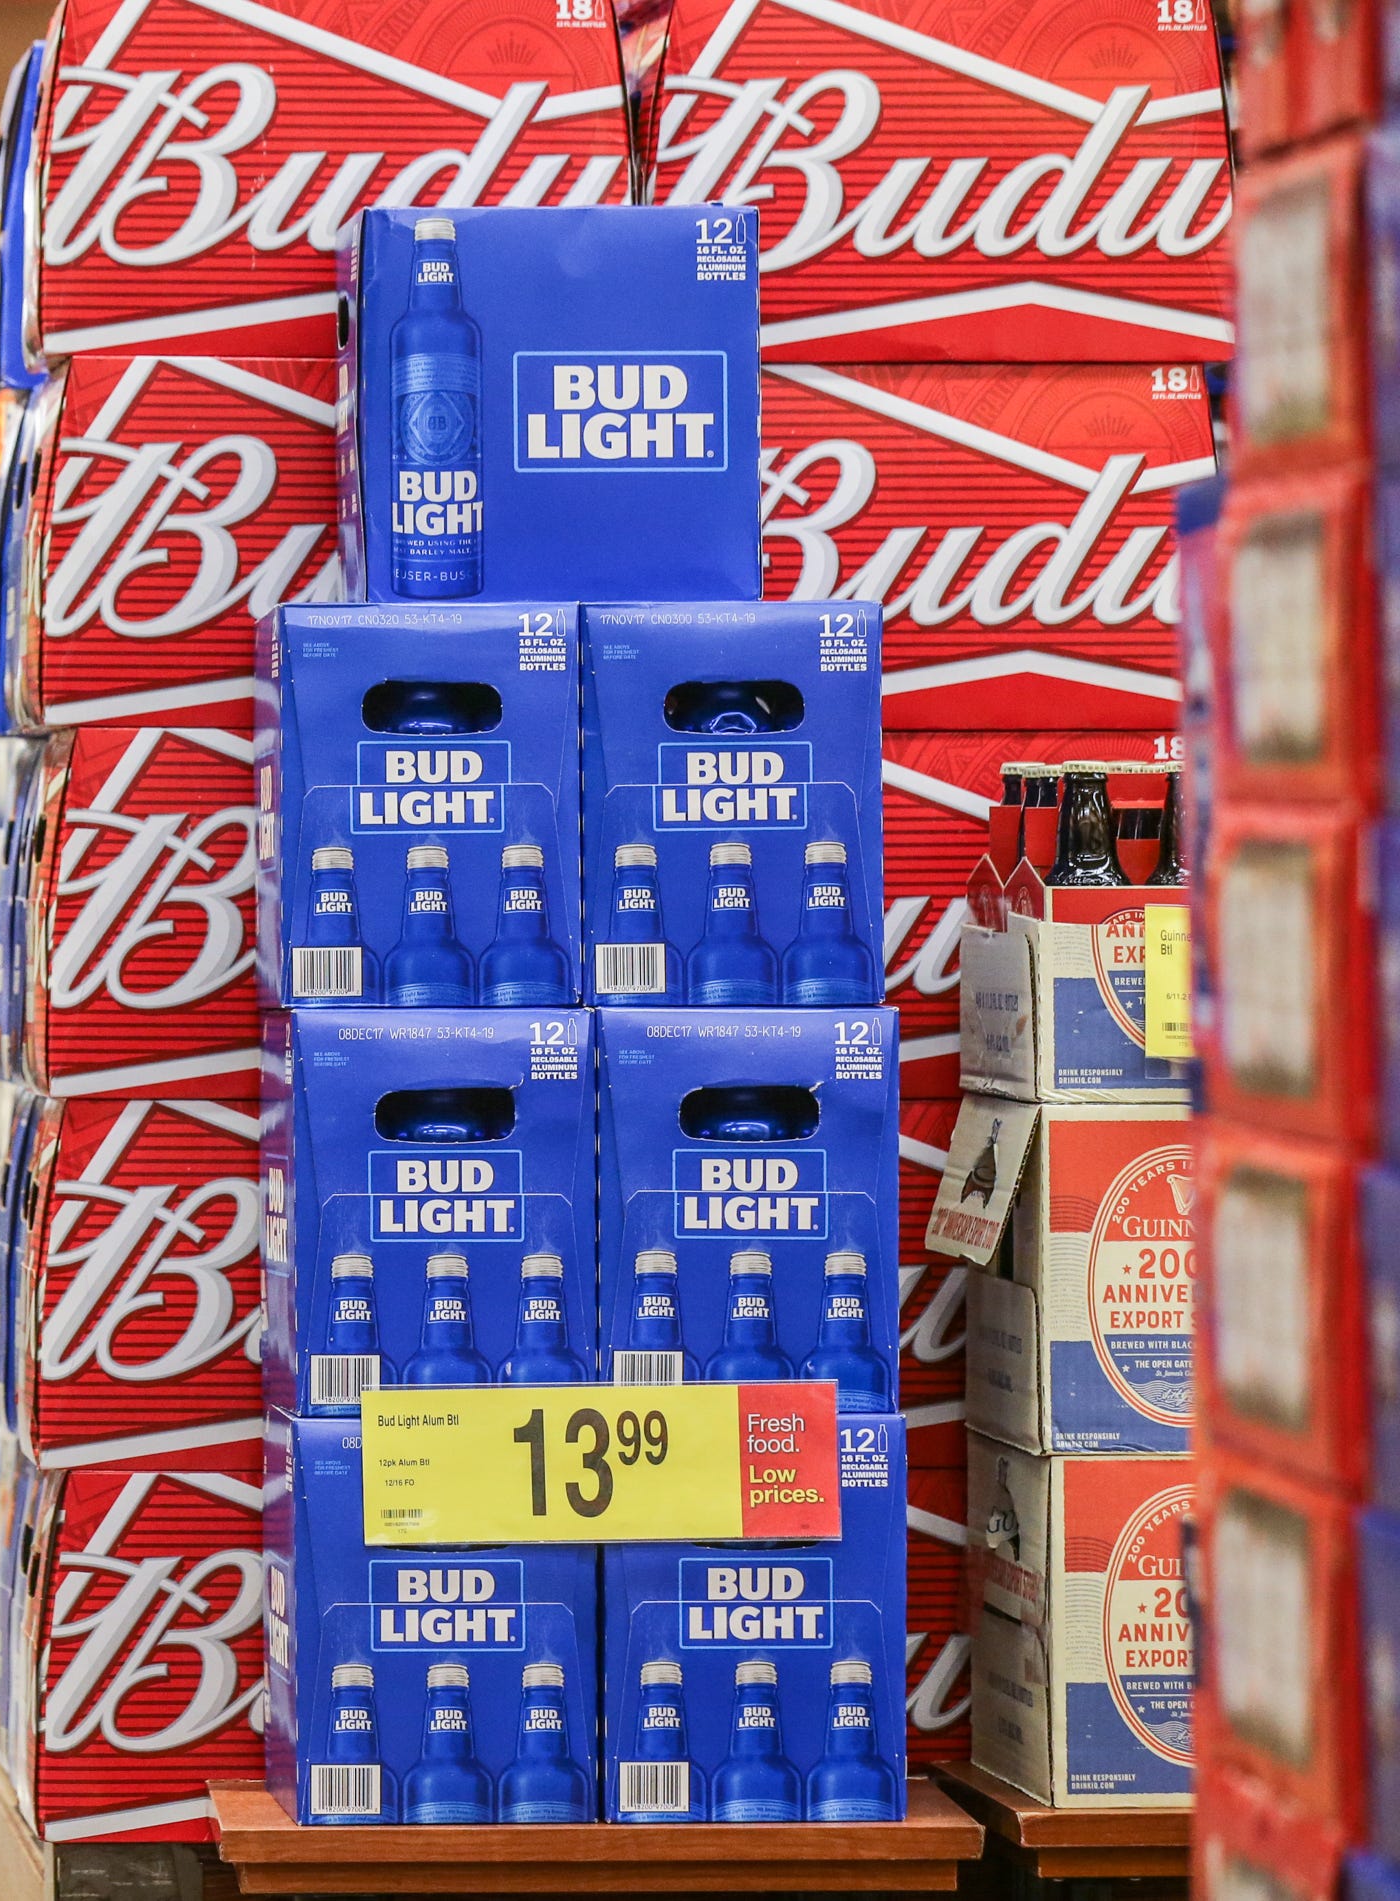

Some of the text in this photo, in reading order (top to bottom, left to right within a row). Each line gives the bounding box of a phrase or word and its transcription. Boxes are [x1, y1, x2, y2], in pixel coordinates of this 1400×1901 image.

[696, 218, 732, 243] 12
[697, 246, 746, 254] 16 FL. OZ.
[420, 262, 452, 274] BUD
[418, 271, 453, 282] LIGHT
[697, 272, 745, 280] BOTTLES
[1152, 368, 1188, 392] 18
[554, 365, 687, 410] BUD
[528, 413, 714, 459] LIGHT
[400, 471, 476, 502] BUD
[393, 501, 483, 535] LIGHT
[308, 614, 462, 625] 17NOV17 CN0320 53-KT4-19
[516, 612, 552, 636] 12
[600, 613, 755, 624] 17NOV17 CN0300 53-KT4-19
[817, 613, 853, 637] 12
[386, 751, 482, 783] BUD
[687, 752, 783, 783] BUD
[360, 791, 494, 824] LIGHT
[663, 788, 797, 821] LIGHT
[321, 892, 347, 902] BUD
[416, 891, 442, 902] BUD
[511, 890, 537, 900] BUD
[624, 889, 650, 899] BUD
[719, 888, 745, 898] BUD
[814, 887, 840, 897] BUD
[411, 901, 447, 911] LIGHT
[506, 900, 541, 910] LIGHT
[619, 898, 655, 909] LIGHT
[714, 897, 750, 909] LIGHT
[809, 896, 845, 907] LIGHT
[316, 902, 352, 913] LIGHT
[1161, 944, 1172, 955] Btl
[339, 1027, 493, 1039] 08DEC17 WR1847 53-KT4-19
[530, 1022, 564, 1044] 12
[647, 1026, 801, 1037] 08DEC17 WR1847 53-KT4-19
[835, 1022, 868, 1044] 12
[397, 1160, 493, 1192] BUD
[701, 1159, 798, 1192] BUD
[1112, 1162, 1175, 1224] 200 YEARS
[380, 1200, 514, 1233] LIGHT
[685, 1197, 818, 1230] LIGHT
[340, 1300, 367, 1311] BUD
[435, 1300, 461, 1311] BUD
[530, 1300, 556, 1311] BUD
[643, 1297, 670, 1307] BUD
[738, 1298, 765, 1307] BUD
[833, 1298, 859, 1308] BUD
[335, 1310, 371, 1320] LIGHT
[430, 1310, 466, 1320] LIGHT
[525, 1310, 560, 1320] LIGHT
[638, 1306, 674, 1316] LIGHT
[733, 1307, 769, 1317] LIGHT
[828, 1307, 863, 1318] LIGHT
[1110, 1311, 1184, 1328] EXPORT
[1111, 1341, 1168, 1349] BREWED WITH
[1135, 1360, 1149, 1368] THE
[1152, 1360, 1172, 1368] OPEN
[378, 1414, 458, 1429] Bud Light Alum Btl
[748, 1414, 804, 1432] Fresh
[747, 1434, 799, 1452] food.
[841, 1428, 875, 1452] 12
[380, 1459, 396, 1467] 12pk
[750, 1465, 795, 1483] Low
[842, 1479, 888, 1487] BOTTLES
[750, 1485, 824, 1507] prices.
[1128, 1501, 1190, 1563] 200 YEARS
[398, 1570, 494, 1602] BUD
[708, 1568, 804, 1600] BUD
[381, 1609, 515, 1642] LIGHT
[689, 1606, 823, 1640] LIGHT
[1126, 1682, 1184, 1690] BREWED WITH
[1150, 1701, 1187, 1709] THE OPEN
[341, 1710, 367, 1720] BUD
[436, 1710, 462, 1720] BUD
[531, 1710, 557, 1720] BUD
[649, 1707, 676, 1717] BUD
[744, 1707, 770, 1717] BUD
[839, 1707, 865, 1717] BUD
[336, 1719, 371, 1730] LIGHT
[431, 1719, 466, 1730] LIGHT
[526, 1719, 561, 1730] LIGHT
[644, 1716, 680, 1727] LIGHT
[739, 1716, 775, 1727] LIGHT
[834, 1716, 869, 1727] LIGHT
